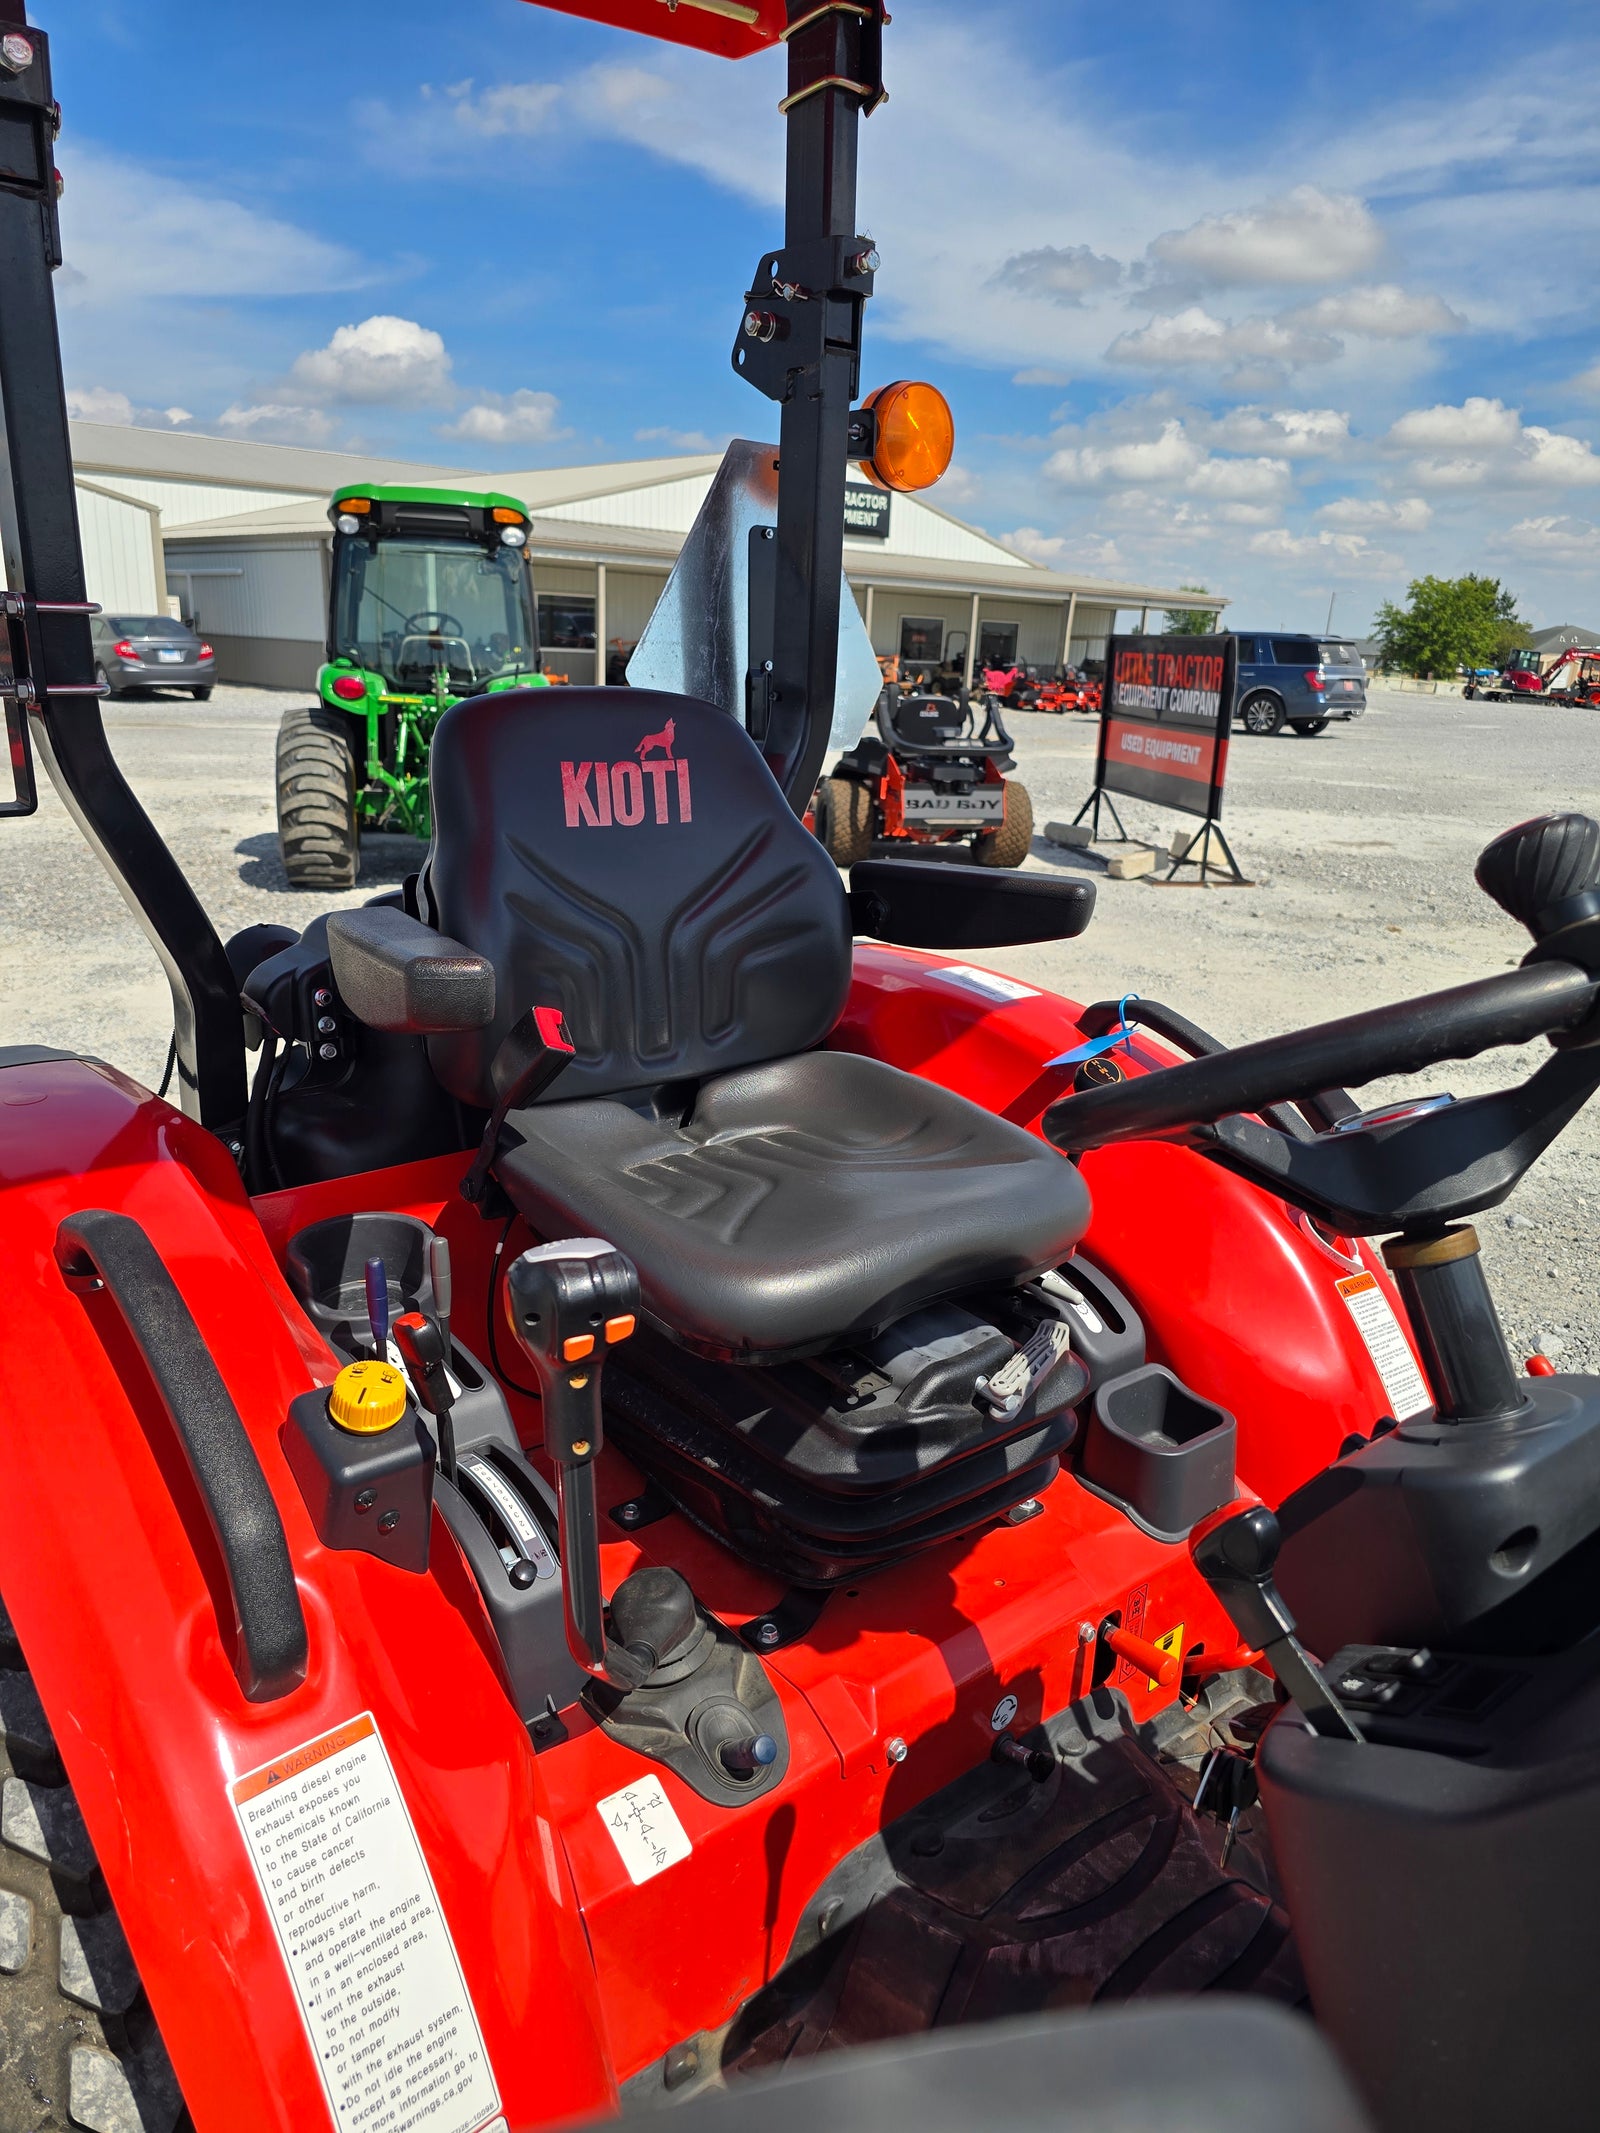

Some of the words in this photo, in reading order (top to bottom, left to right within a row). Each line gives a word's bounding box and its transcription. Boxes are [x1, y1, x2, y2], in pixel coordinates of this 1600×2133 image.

[1114, 651, 1153, 685] LITTLE
[1157, 653, 1224, 691] TRACTOR
[1119, 683, 1170, 710] EQUIPMENT
[1170, 688, 1221, 717] COMPANY
[1121, 733, 1143, 753] USED
[1144, 740, 1202, 765] EQUIPMENT
[561, 759, 692, 827] KIOTI
[906, 800, 950, 809] BAD
[957, 800, 999, 809] BOY
[282, 1735, 346, 1774] WARNING
[248, 1791, 298, 1823] Breathing
[301, 1770, 331, 1794] diesel
[335, 1753, 367, 1776] engine
[255, 1810, 295, 1839] exhaust
[299, 1787, 340, 1815] exposes
[342, 1775, 361, 1792] you
[260, 1844, 271, 1856] to
[275, 1814, 326, 1847] chemicals
[328, 1795, 360, 1818] known
[266, 1861, 277, 1872] to
[280, 1849, 298, 1864] the
[301, 1832, 328, 1853] State
[332, 1822, 342, 1836] of
[345, 1797, 391, 1827] California
[271, 1878, 283, 1889] to
[287, 1858, 317, 1881] cause
[321, 1835, 354, 1861] cancer
[277, 1886, 297, 1906] and
[300, 1872, 326, 1893] birth
[329, 1849, 366, 1876] defects
[283, 1910, 293, 1923] or
[298, 1892, 324, 1914] other
[288, 1898, 350, 1941] reproductive
[352, 1882, 380, 1902] harm.
[300, 1927, 335, 1954] Always
[339, 1909, 362, 1930] start
[305, 1951, 324, 1971] and
[328, 1928, 366, 1957] operate
[369, 1916, 386, 1931] the
[389, 1894, 421, 1918] engine
[309, 1976, 320, 1988] in
[323, 1969, 331, 1980] a
[334, 1919, 407, 1972] well-ventilated
[410, 1904, 435, 1925] area.
[314, 1992, 322, 2006] If
[326, 1987, 336, 1999] in
[340, 1976, 353, 1990] an
[356, 1944, 400, 1980] enclosed
[403, 1930, 428, 1950] area,
[320, 2001, 343, 2022] vent
[346, 1990, 363, 2006] the
[367, 1961, 405, 1993] exhaust
[326, 2027, 337, 2040] to
[340, 2014, 357, 2030] the
[361, 1987, 401, 2017] outside.
[330, 2043, 345, 2057] Do
[349, 2027, 365, 2046] not
[368, 2005, 400, 2032] modify
[337, 2060, 347, 2074] or
[351, 2035, 385, 2064] tamper
[341, 2071, 363, 2091] with
[366, 2058, 383, 2075] the
[386, 2028, 424, 2061] exhaust
[427, 2005, 463, 2033] system.
[346, 2094, 361, 2109] Do
[364, 2078, 381, 2096] not
[384, 2064, 403, 2083] idle
[406, 2051, 423, 2067] the
[426, 2026, 458, 2054] engine
[352, 2094, 386, 2126] except
[389, 2085, 402, 2100] as
[405, 2048, 458, 2088] necessary.
[371, 2110, 396, 2131] more
[399, 2071, 451, 2113] information
[454, 2060, 466, 2075] go
[468, 2051, 478, 2063] to
[388, 2074, 473, 2133] 5warnings.ca.gov
